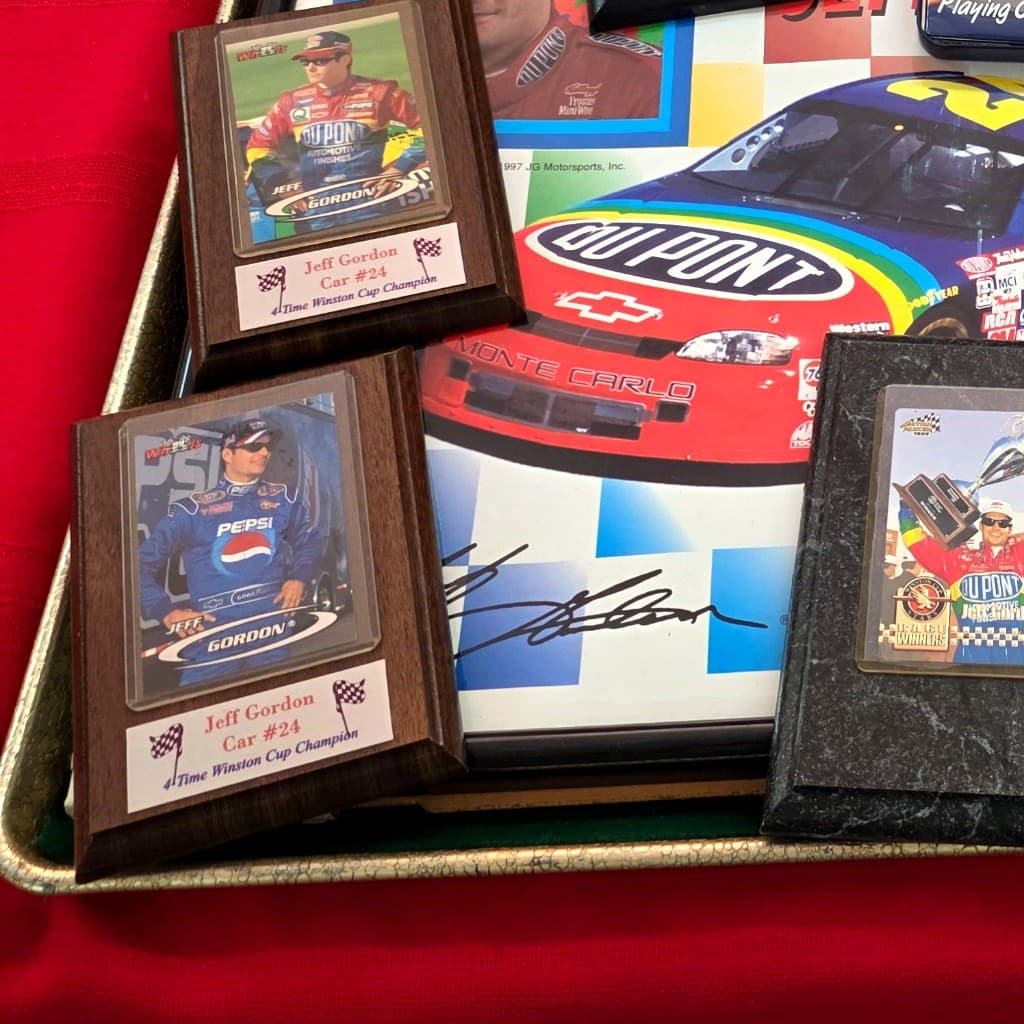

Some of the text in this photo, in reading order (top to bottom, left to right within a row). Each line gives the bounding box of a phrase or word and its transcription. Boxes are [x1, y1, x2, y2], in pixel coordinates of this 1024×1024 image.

[543, 160, 626, 173] Motorsports, Inc.
[271, 181, 303, 196] JEFF
[307, 185, 376, 210] GORDON
[304, 246, 399, 276] Jeff Gordon
[312, 274, 438, 308] Winston Cup Champion
[320, 265, 388, 291] Car #24
[998, 276, 1018, 290] MCI
[455, 336, 697, 401] MONTE CARLO
[216, 516, 274, 538] PEPSI
[165, 616, 205, 636] JEFF
[207, 621, 288, 653] GORDON
[203, 692, 316, 735] Jeff Gordon
[221, 717, 302, 754] Car #24
[211, 728, 360, 777] Winston Cup Champion
